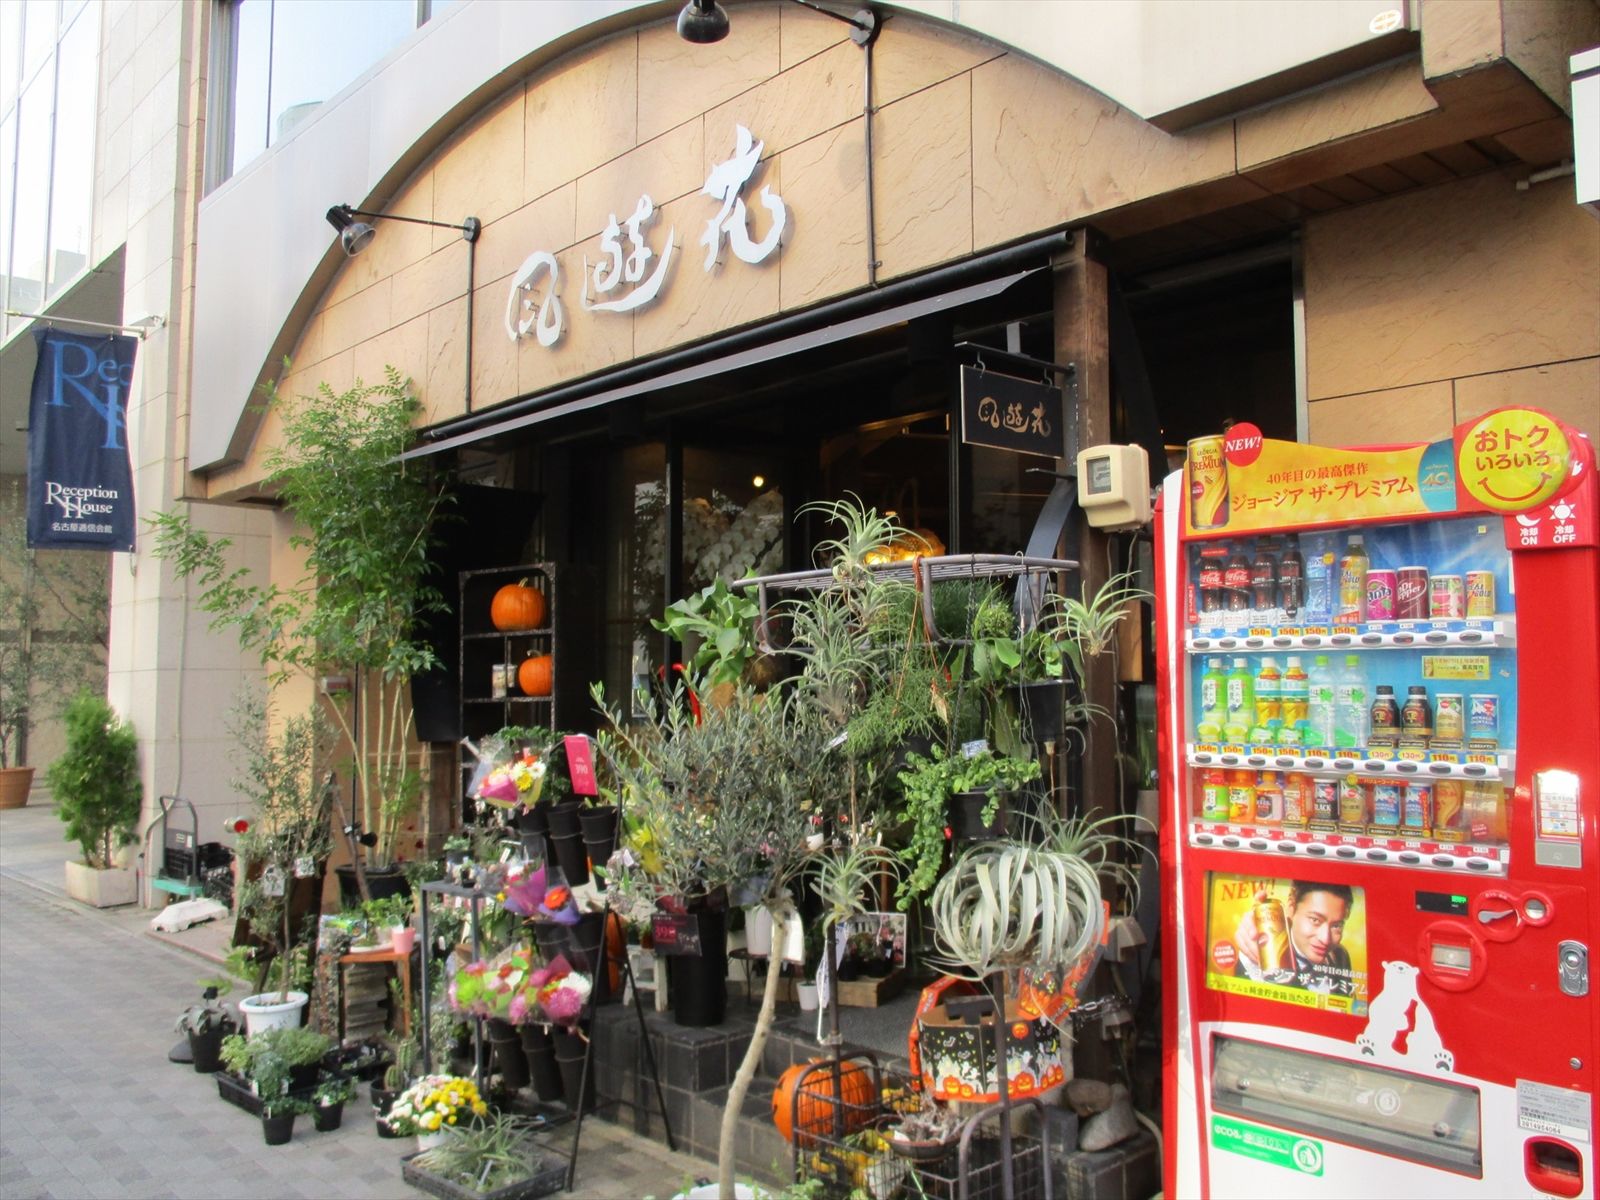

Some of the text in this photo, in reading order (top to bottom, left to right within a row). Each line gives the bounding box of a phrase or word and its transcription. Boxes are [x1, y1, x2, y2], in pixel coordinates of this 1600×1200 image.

[1224, 436, 1263, 452] NEW!
[1474, 425, 1550, 452] おトク
[1475, 450, 1552, 471] いろいろ
[1266, 462, 1369, 485] 40年目の最高傑作
[45, 482, 119, 506] Reception
[1232, 476, 1415, 513] ジョージア ザ・プレミアム
[63, 496, 114, 519] House
[1519, 527, 1538, 537] 冷却
[1552, 534, 1576, 544] OFF
[1554, 525, 1575, 534] 冷却
[1520, 536, 1538, 545] ON
